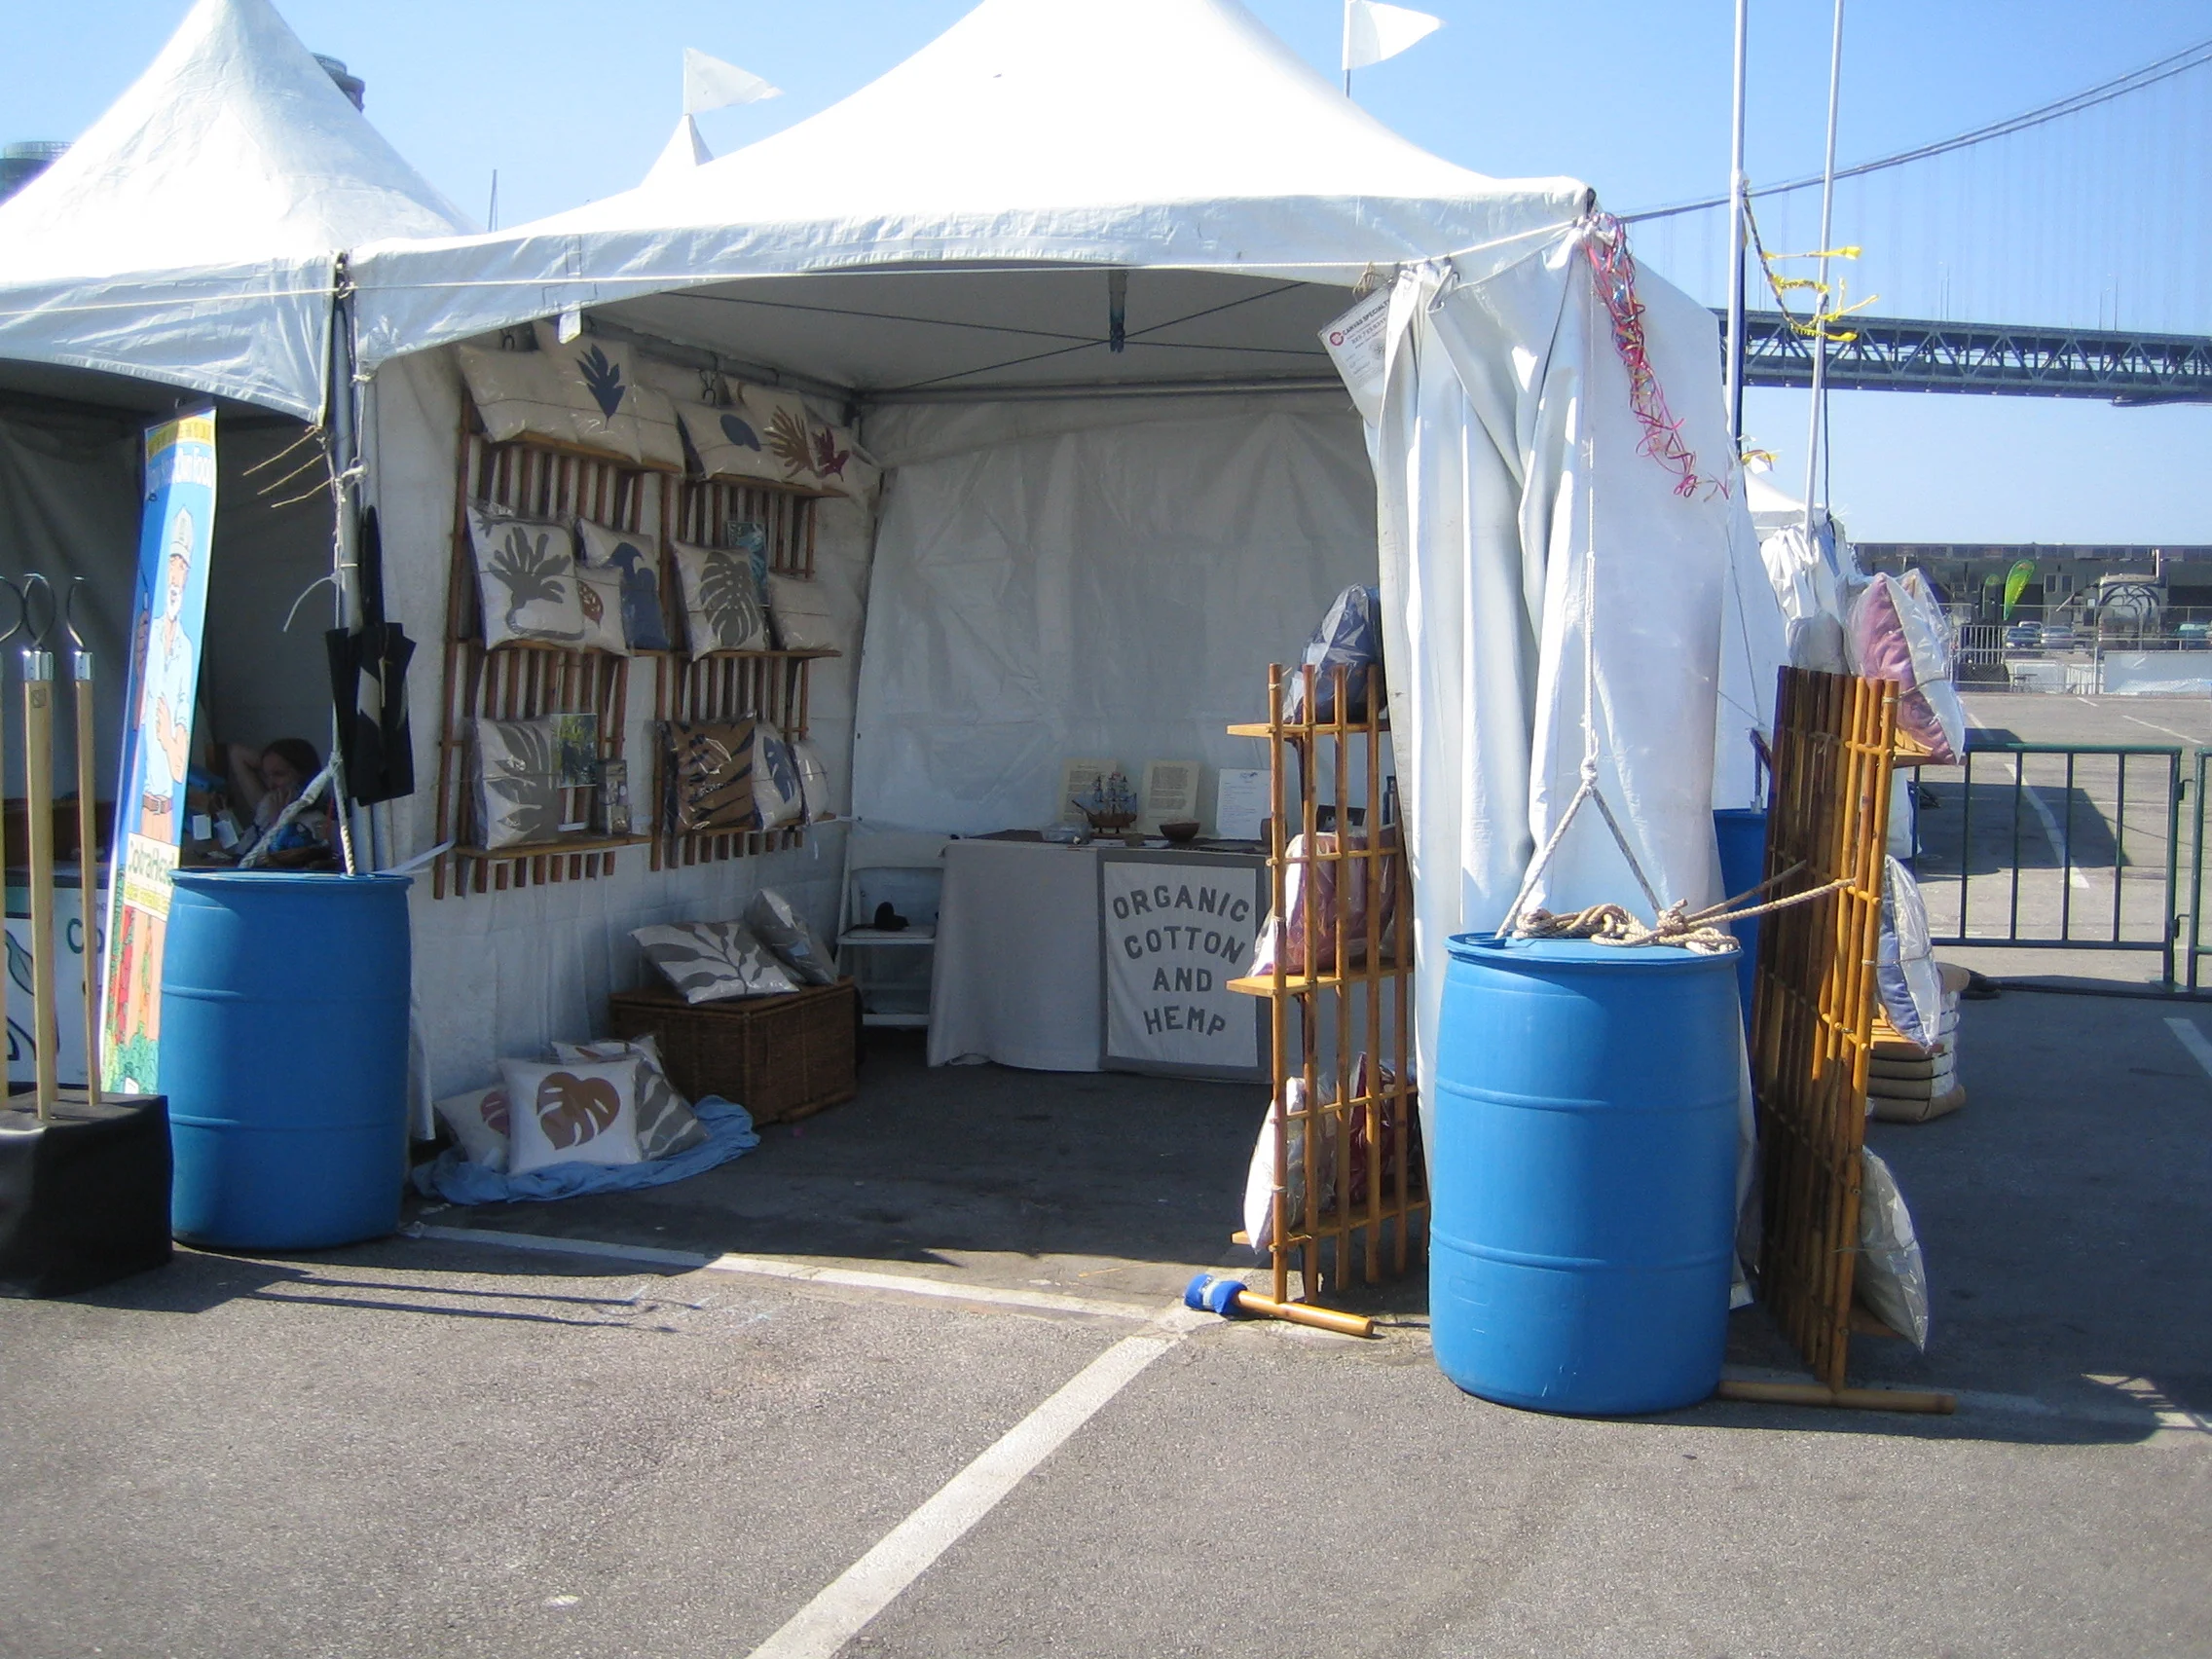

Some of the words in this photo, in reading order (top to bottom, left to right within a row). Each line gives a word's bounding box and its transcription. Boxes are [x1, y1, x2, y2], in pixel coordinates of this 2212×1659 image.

[1113, 884, 1249, 922] ORGANIC
[1124, 926, 1246, 964] COTTON
[1153, 967, 1212, 992] AND
[1143, 1006, 1226, 1036] HEMP
